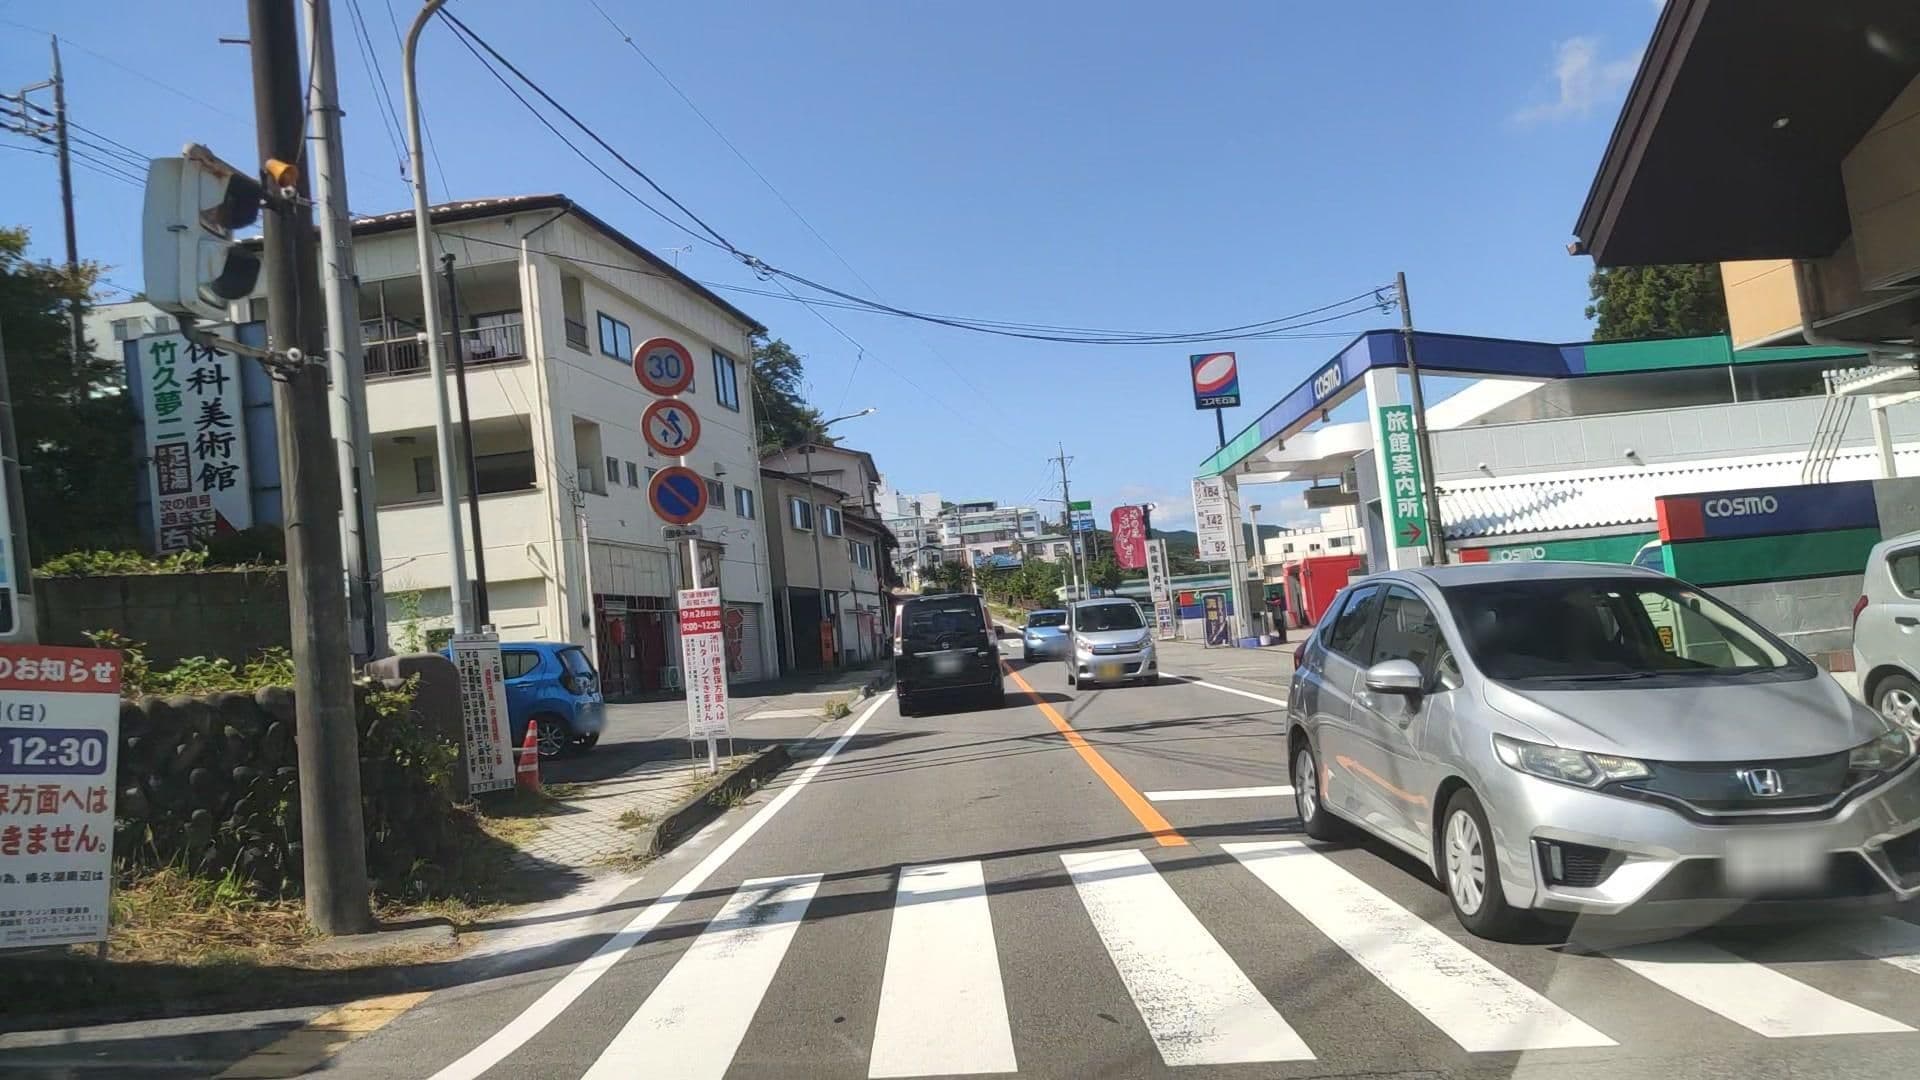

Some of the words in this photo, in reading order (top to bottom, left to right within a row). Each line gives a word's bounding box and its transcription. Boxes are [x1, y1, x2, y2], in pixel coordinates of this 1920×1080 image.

[648, 354, 680, 379] 30
[1314, 363, 1342, 400] COSMO
[149, 340, 186, 440] 竹久夢二
[1200, 396, 1236, 406] コスモ石油
[1386, 410, 1419, 518] 旅館案内所
[1705, 495, 1779, 518] COSMO
[0, 736, 103, 767] 12:30
[1, 824, 106, 855] きません。
